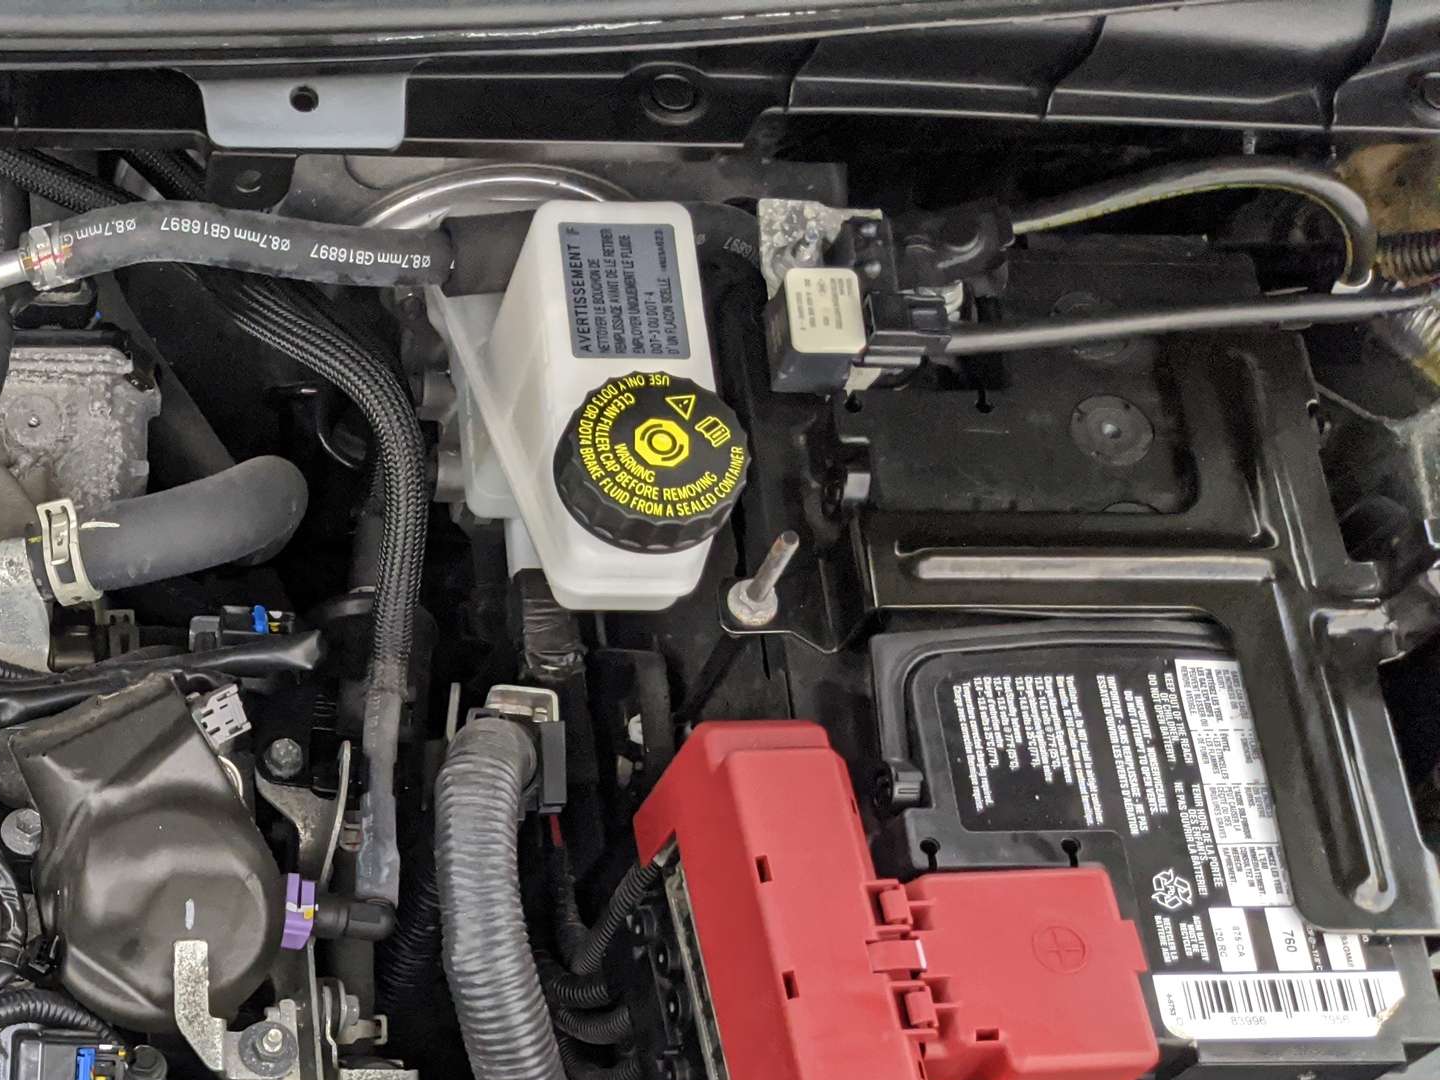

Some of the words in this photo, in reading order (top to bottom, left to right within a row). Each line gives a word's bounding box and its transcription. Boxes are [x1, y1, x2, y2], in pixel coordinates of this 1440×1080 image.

[160, 216, 231, 240] GB16897
[310, 243, 374, 265] GB16897
[588, 258, 599, 267] DE
[604, 259, 616, 267] LE
[622, 260, 634, 268] LE
[606, 269, 617, 278] DE
[568, 244, 592, 352] AVERTISSEMENT
[607, 281, 620, 303] AVANT
[594, 306, 605, 314] LE
[648, 317, 659, 327] OU
[595, 316, 610, 353] NETTOYER
[617, 375, 645, 391] ONLY
[649, 374, 670, 386] USE
[591, 384, 618, 406] DOT3
[583, 404, 599, 420] OR
[603, 393, 635, 419] CLEAN
[578, 419, 594, 445] DOT4
[595, 417, 612, 452] FILLER
[579, 447, 605, 480] BRAKE
[600, 453, 620, 472] CAP
[614, 443, 655, 483] WARNING
[714, 446, 744, 498] CONTAINER
[599, 477, 630, 504] FLUID
[615, 471, 659, 500] BEFORE
[663, 471, 717, 501] REMOVING
[630, 496, 663, 516] FROM
[666, 503, 674, 517] A
[676, 493, 717, 516] SEALED
[1147, 673, 1157, 686] DO
[1196, 666, 1204, 676] LES
[982, 676, 993, 697] Charge
[1096, 674, 1111, 708] ESSAYER
[1163, 672, 1175, 692] KEEP
[961, 681, 976, 719] Temperature
[1106, 675, 1123, 718] IMPORTANT
[1123, 689, 1133, 701] DO
[1150, 686, 1161, 703] NOT
[1159, 692, 1169, 704] OF
[1168, 693, 1179, 709] OUT
[1211, 695, 1219, 706] LES
[952, 685, 964, 707] Charge
[959, 722, 974, 753] correction
[979, 711, 989, 725] volts
[999, 710, 1009, 725] volts
[1021, 710, 1031, 725] volts
[1041, 710, 1051, 724] volts
[1126, 701, 1136, 717] NOT
[1154, 703, 1166, 725] OPEN
[1172, 710, 1182, 721] OF
[1103, 709, 1119, 744] D'OUVRIR
[1162, 703, 1178, 743] CHILDREN.
[1175, 722, 1186, 738] THE
[968, 719, 982, 749] corrected
[1116, 724, 1128, 744] SANS
[1129, 717, 1145, 754] ATTEMPT
[1159, 725, 1175, 763] BATTERY!
[1197, 736, 1204, 745] DE
[1204, 737, 1213, 748] LES
[1212, 736, 1221, 748] LES
[1111, 744, 1122, 758] LES
[1134, 695, 1151, 739] IMPORTANT
[1146, 746, 1167, 813] NONSERVICEABLE
[1138, 754, 1147, 765] TO
[1179, 737, 1193, 764] REACH
[1199, 745, 1209, 764] FUMER
[1207, 748, 1219, 774] FLAMMES
[974, 749, 987, 776] charging
[1121, 745, 1140, 798] REMPLISSAGE
[1140, 765, 1152, 787] OPEN
[1173, 782, 1184, 793] NE
[1191, 783, 1203, 807] TENIR
[1224, 785, 1234, 800] PEUT
[1133, 803, 1144, 814] NE
[1145, 787, 1158, 815] VENTS.
[1175, 794, 1187, 810] PAS
[1228, 800, 1239, 823] CAUSER
[1136, 815, 1148, 831] PAS
[1180, 811, 1194, 842] OUVRIR
[1187, 808, 1198, 824] DES
[1196, 808, 1209, 831] HORS
[1191, 825, 1208, 863] ENFANTS.
[1201, 831, 1211, 843] DE
[1187, 843, 1196, 854] LA
[1205, 844, 1214, 855] LA
[1208, 855, 1224, 888] PORTÉE
[1239, 846, 1252, 878] CONSULTEZ
[1190, 854, 1207, 896] BATTERIE!
[1154, 916, 1167, 947] BATTERIE
[1162, 917, 1175, 951] RECYCLER
[1169, 951, 1178, 960] LA
[1179, 922, 1192, 957] RECYCLED
[1187, 923, 1196, 943] MUST
[1282, 930, 1298, 953] 760
[1191, 943, 1199, 953] BE
[1196, 931, 1209, 962] BATTERY
